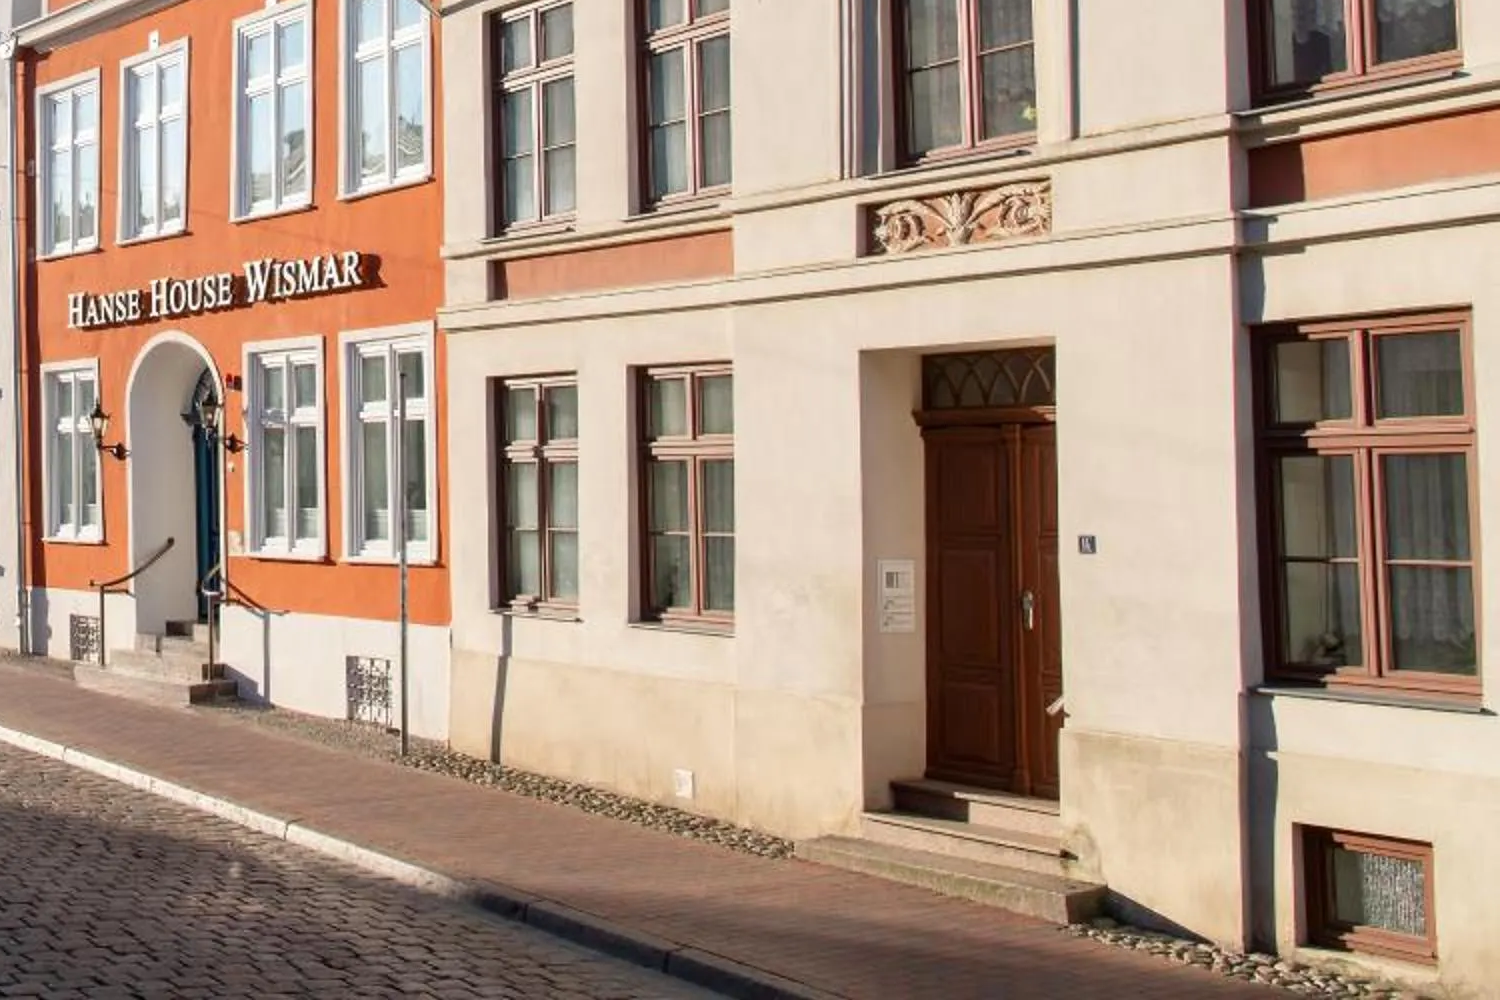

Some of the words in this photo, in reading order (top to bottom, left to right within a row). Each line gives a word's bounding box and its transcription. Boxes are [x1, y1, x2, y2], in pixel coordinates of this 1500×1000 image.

[68, 290, 141, 329] HANSE
[149, 273, 233, 318] HOUSE
[242, 251, 363, 303] WISMAR
